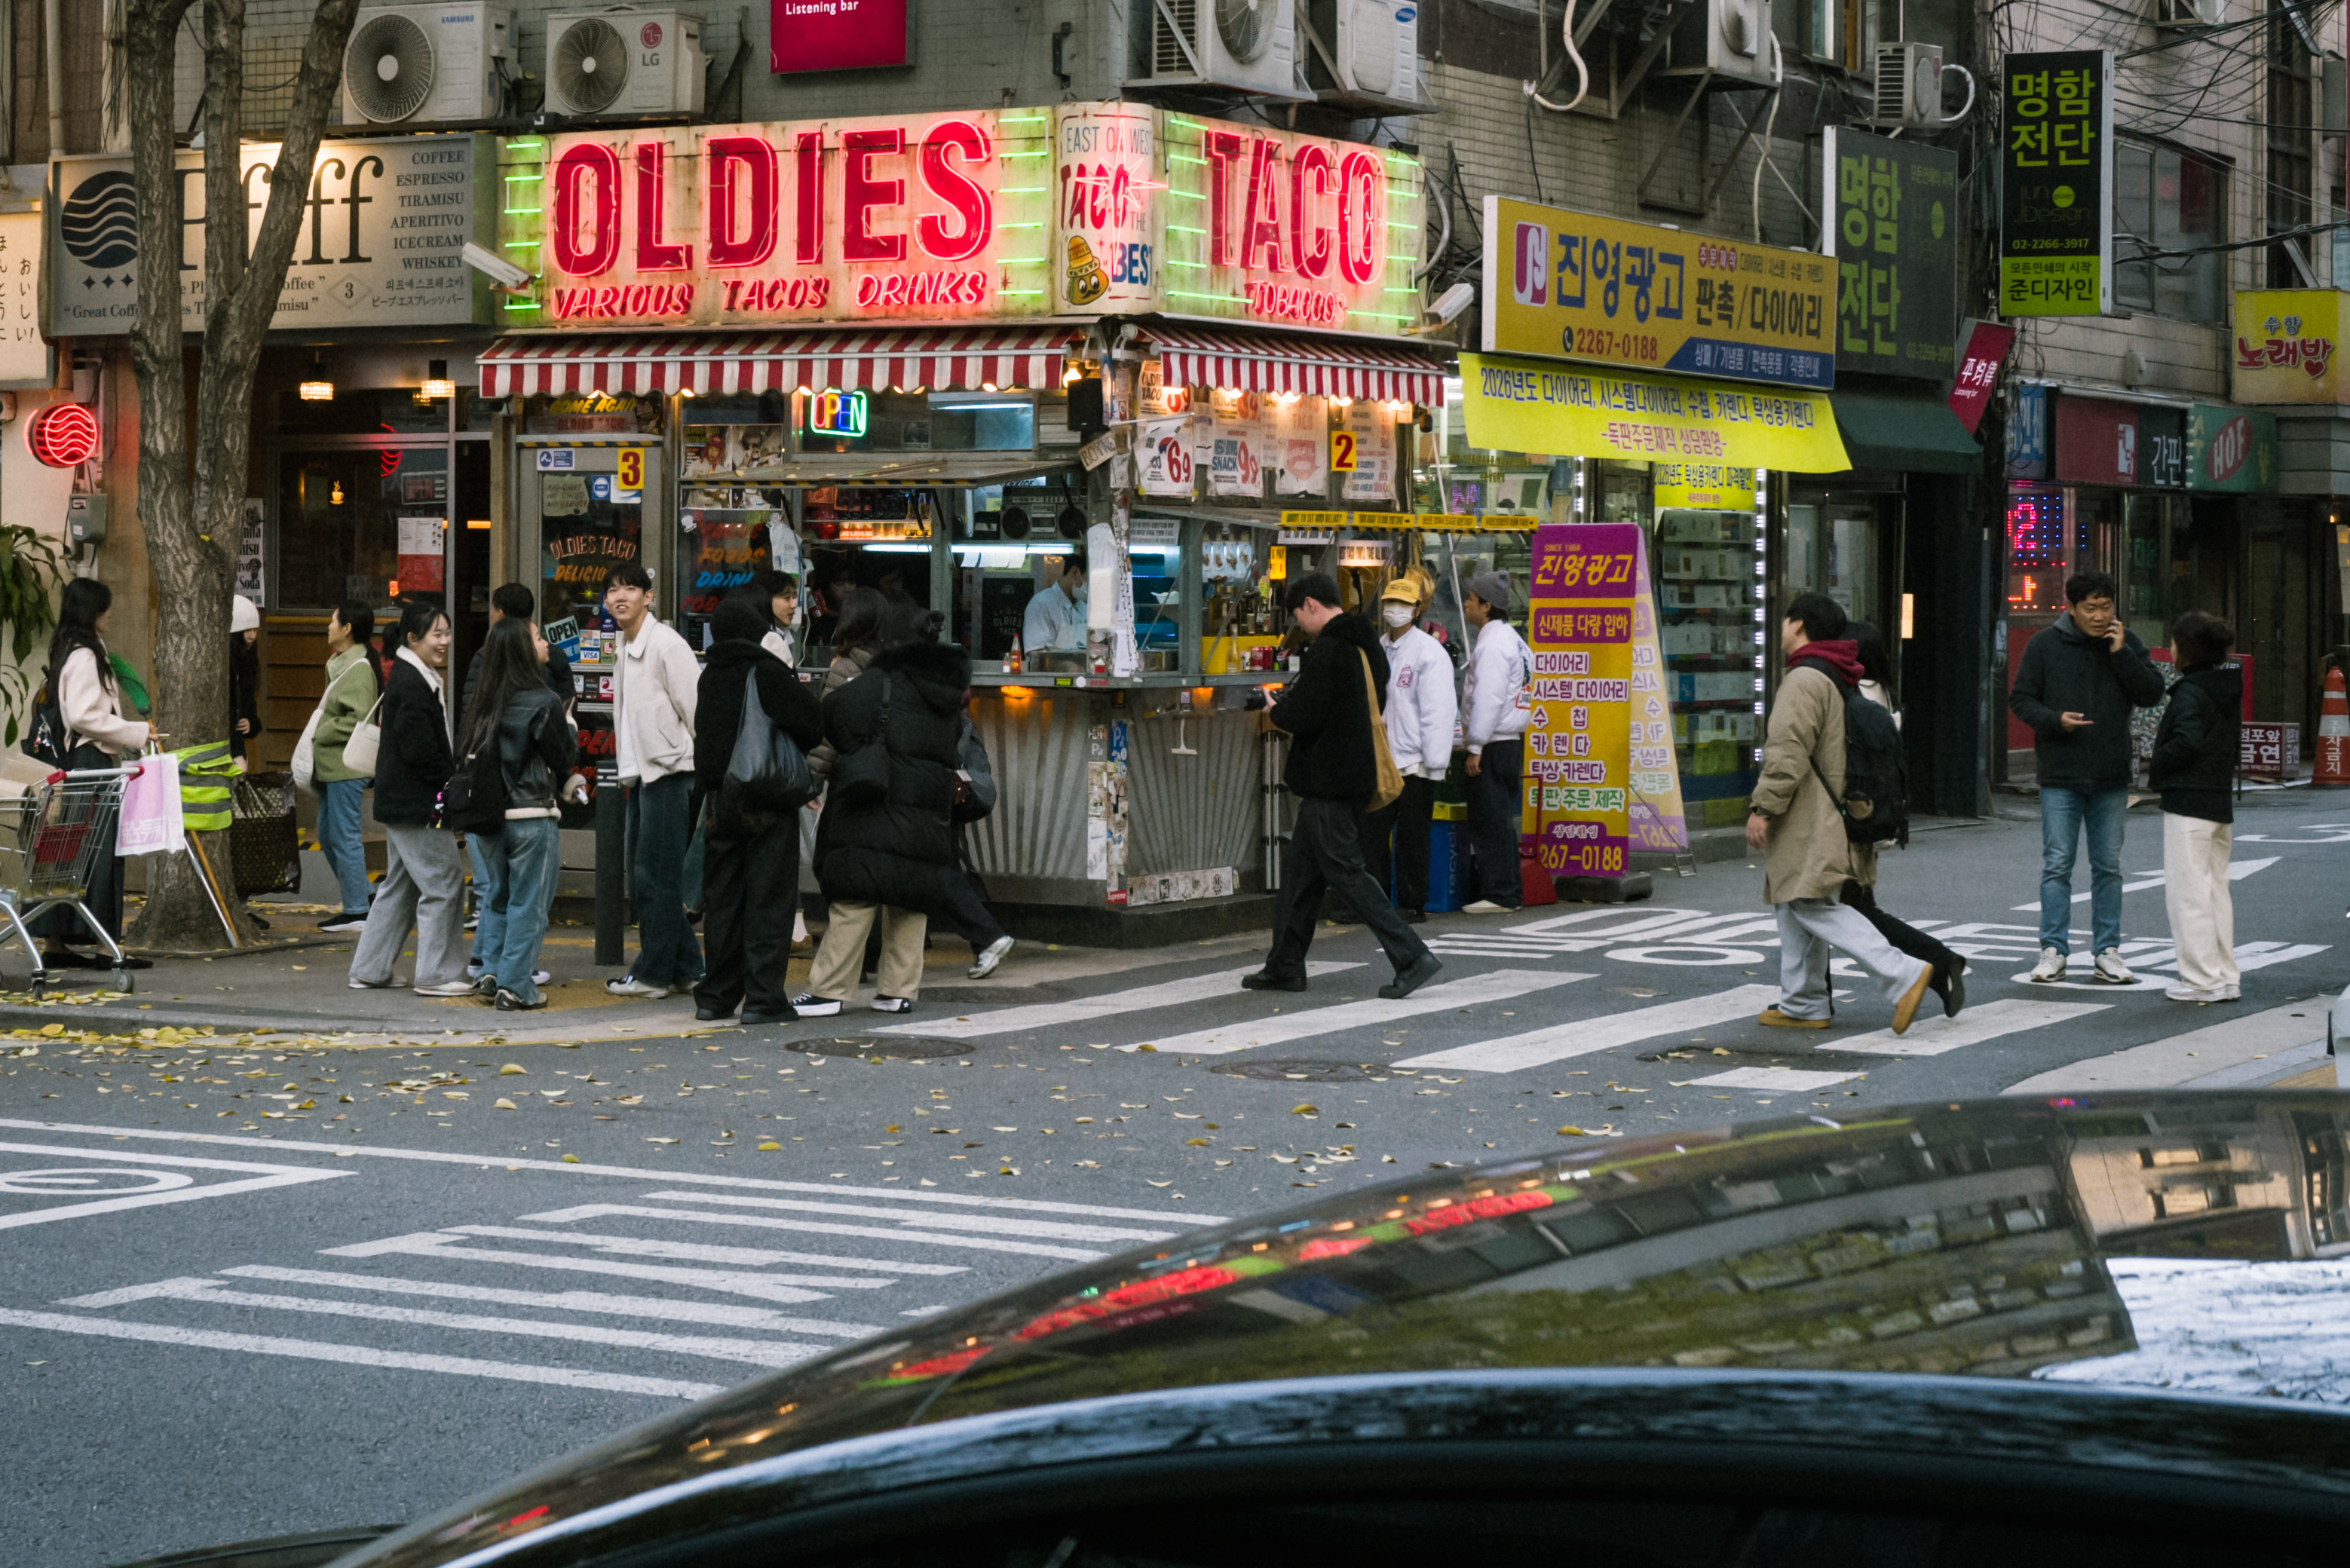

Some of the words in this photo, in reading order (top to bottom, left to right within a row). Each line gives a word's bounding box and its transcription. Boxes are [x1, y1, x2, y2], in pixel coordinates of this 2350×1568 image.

[441, 14, 474, 23] SAMSUNG
[786, 2, 836, 15] Listening
[840, 0, 859, 11] bar
[642, 53, 660, 66] LG
[2012, 69, 2096, 118] 명함
[1067, 127, 1100, 153] EAST
[2011, 120, 2096, 167] 전단
[412, 151, 464, 164] COFFEE
[396, 172, 464, 186] ESPRESSO
[399, 192, 464, 207] TIRAMISU
[547, 119, 991, 278] OLDIES
[1061, 163, 1129, 231] TACO
[1208, 128, 1386, 286] TACO
[1840, 154, 1901, 254] 명함
[170, 155, 383, 271] Pfff
[391, 214, 464, 228] APERITIVO
[1130, 212, 1146, 231] THE
[393, 234, 464, 250] ICECREAM
[2012, 238, 2089, 250] 02-2266-3917
[402, 256, 463, 270] WHISKEY
[1111, 242, 1153, 286] BEST
[2011, 262, 2065, 274] 모든인쇄의
[2070, 262, 2091, 274] 시작
[1556, 233, 1685, 324] 진영광고
[2008, 278, 2093, 301] 준디자인
[345, 282, 354, 299] 3
[550, 283, 693, 320] VARIOUS
[721, 275, 829, 311] TACOS
[855, 271, 987, 308] DRINKS
[1244, 280, 1347, 324] TOBACCOS
[1839, 259, 1901, 357] 전단
[1577, 326, 1659, 362] 2267-0188
[2237, 336, 2334, 378] 노래방
[1142, 372, 1163, 386] OLDIE
[550, 400, 593, 414] COME
[1481, 367, 1538, 401] 2026년도
[1542, 373, 1596, 408] 다이어리,
[1752, 396, 1814, 429] 탁상용카렌다
[814, 394, 864, 431] OPEN
[1335, 434, 1353, 468] 2
[2214, 418, 2244, 479] HOF
[622, 451, 641, 486] 3
[1212, 456, 1239, 472] SNACK
[548, 535, 596, 561] OLDIES
[599, 534, 637, 562] TACO
[697, 547, 766, 564] FOODS
[1535, 554, 1634, 586] 진영광고
[239, 575, 260, 590] Soda
[547, 619, 579, 643] OPEN
[993, 616, 1022, 627] OLDIES
[1539, 614, 1574, 637] 신제품
[1577, 614, 1601, 638] 다량
[1604, 614, 1628, 637] 입하
[583, 651, 598, 660] VISA
[1535, 654, 1588, 673] 다이어리
[1533, 680, 1573, 700] 시스템
[1576, 681, 1629, 700] 다이어리
[1563, 763, 1604, 781] 카렌다
[1563, 789, 1591, 808] 주문
[1595, 789, 1624, 810] 제작
[1530, 844, 1622, 871] 267-0188
[1107, 891, 1127, 902] Supreme
